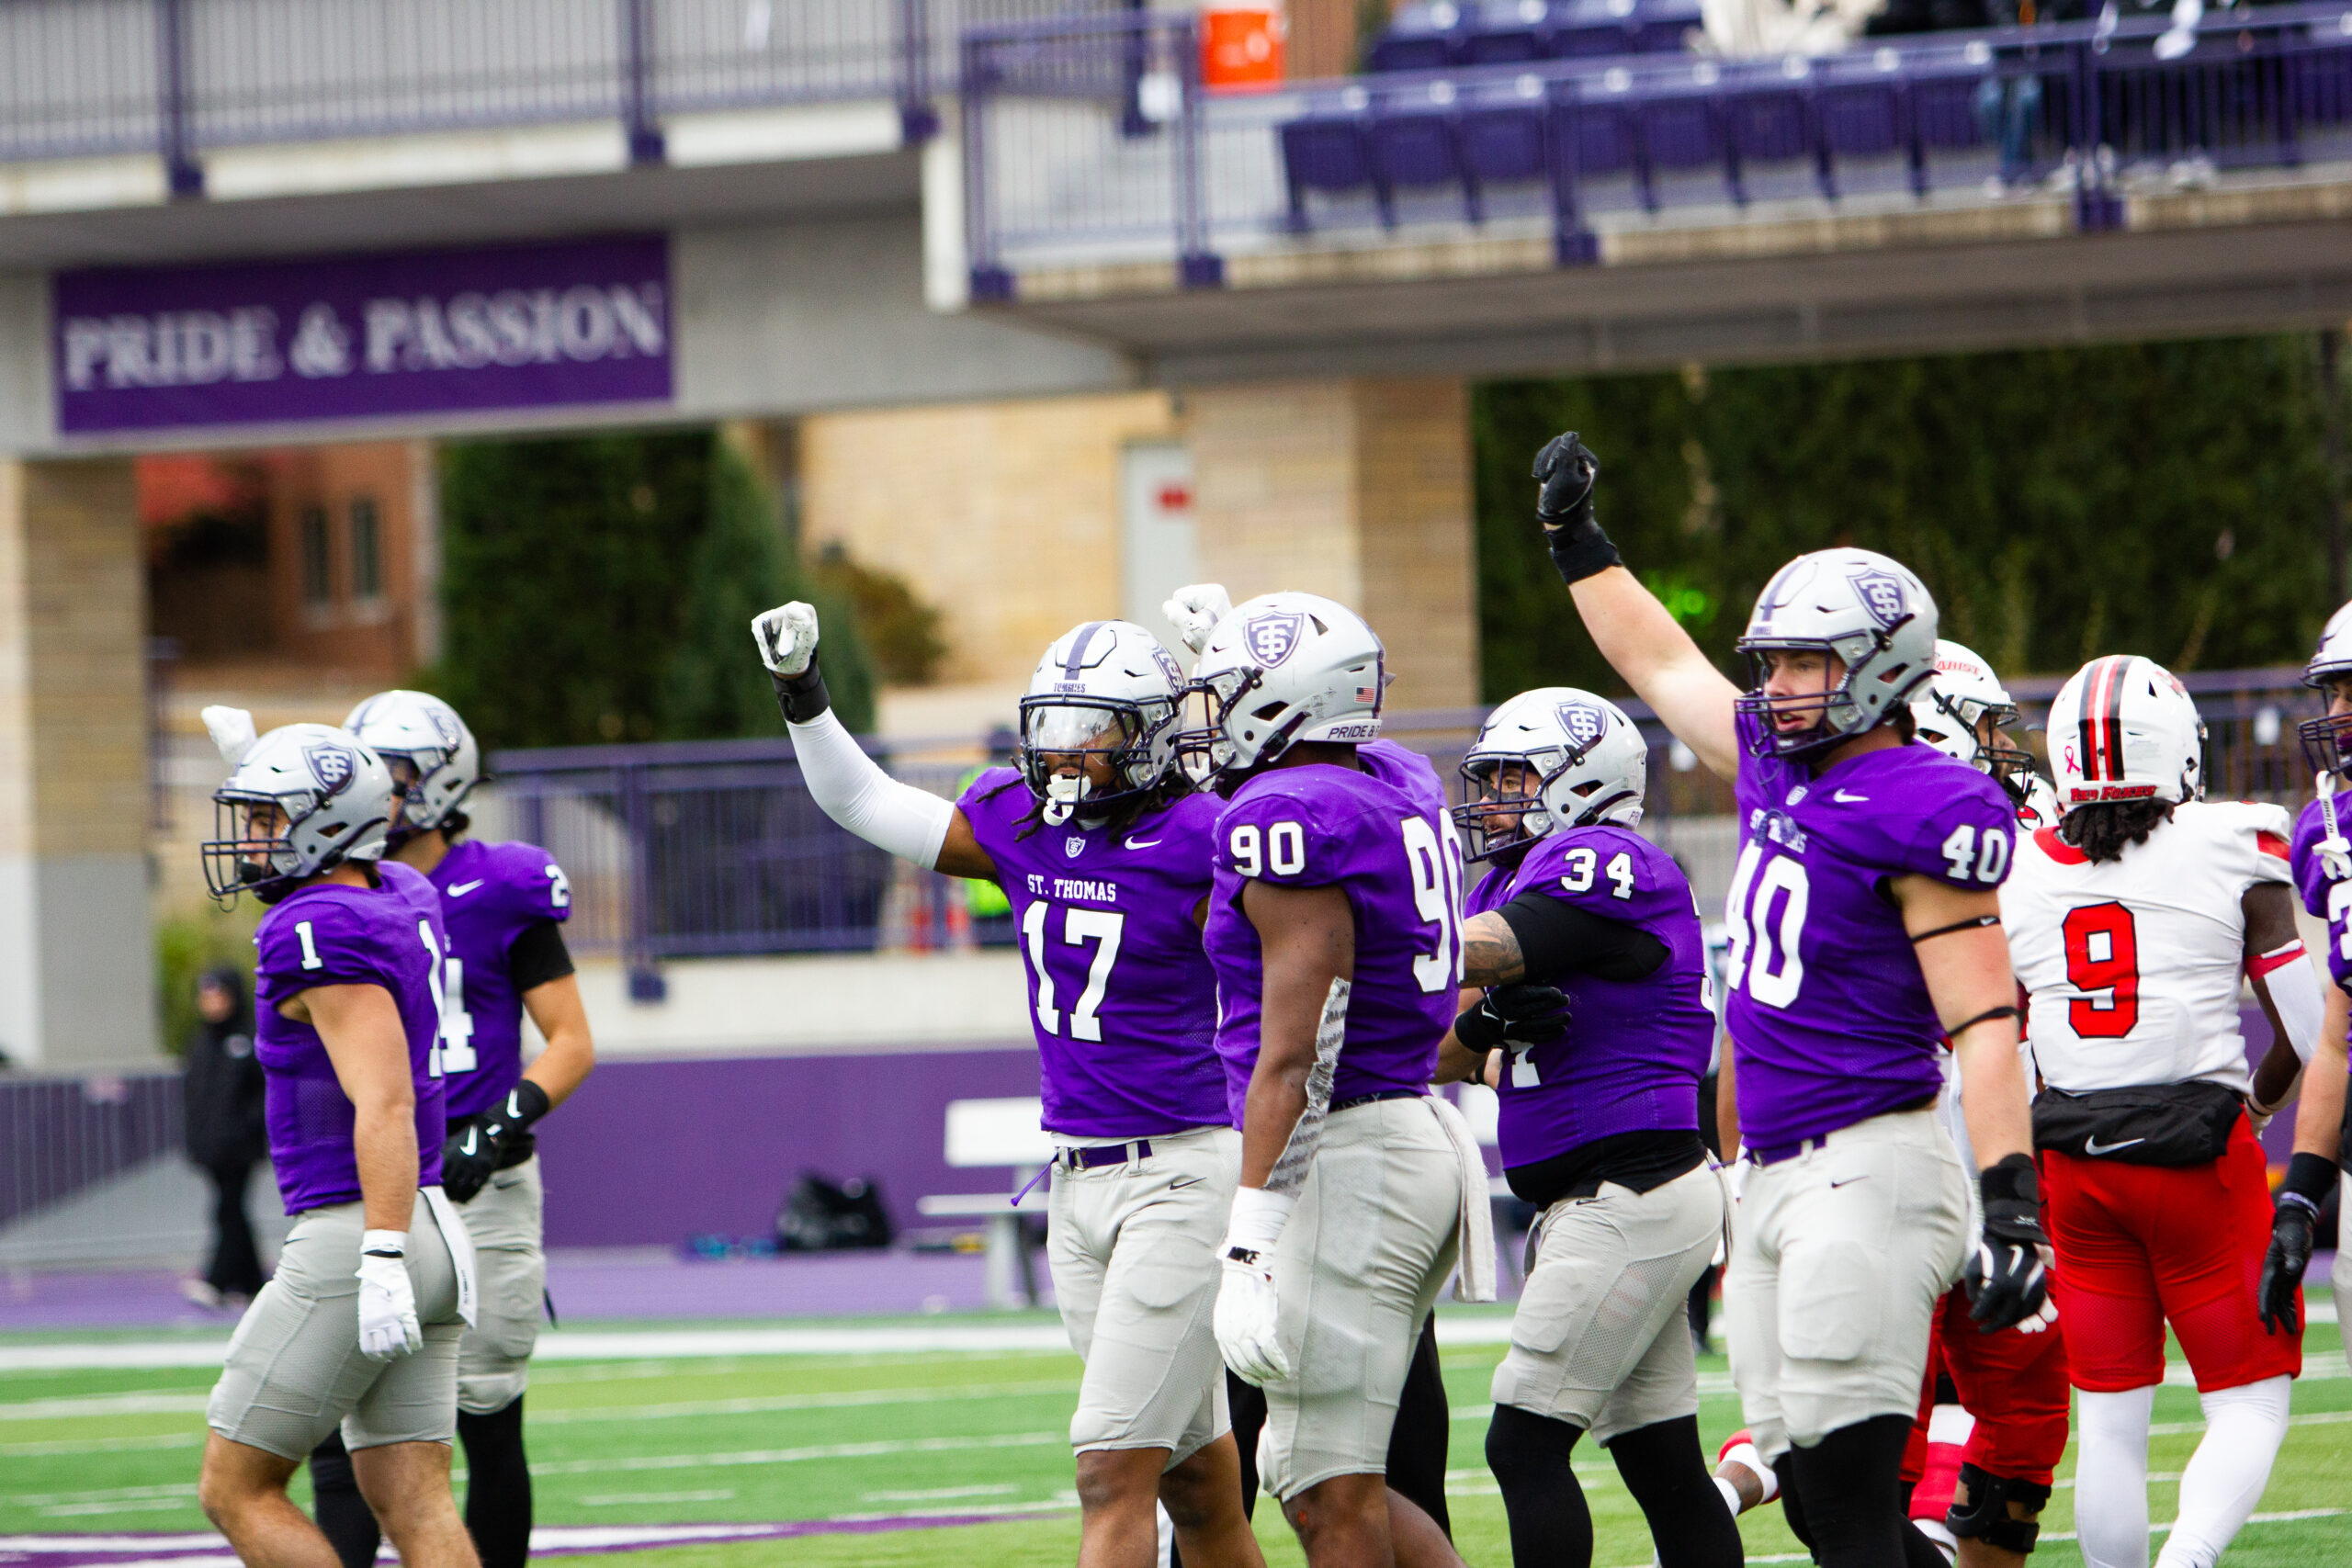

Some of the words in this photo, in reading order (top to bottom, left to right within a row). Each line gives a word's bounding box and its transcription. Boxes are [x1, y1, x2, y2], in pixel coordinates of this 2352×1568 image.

[64, 306, 281, 390] PRIDE
[290, 301, 350, 378] &
[363, 283, 665, 374] PASSION
[1054, 682, 1086, 694] TOMMIES
[1935, 660, 1980, 675] ARIST
[1328, 725, 1368, 739] PRIDE
[1230, 821, 1306, 878] 90
[1560, 848, 1634, 900] 34
[1941, 824, 2008, 884] 40
[1027, 874, 1049, 895] ST.
[1054, 878, 1116, 902] THOMAS
[295, 920, 323, 971] 1
[1725, 838, 1810, 1010] 40
[1022, 900, 1125, 1043] 17
[2062, 901, 2140, 1039] 9
[1227, 1246, 1261, 1265] NIKE
